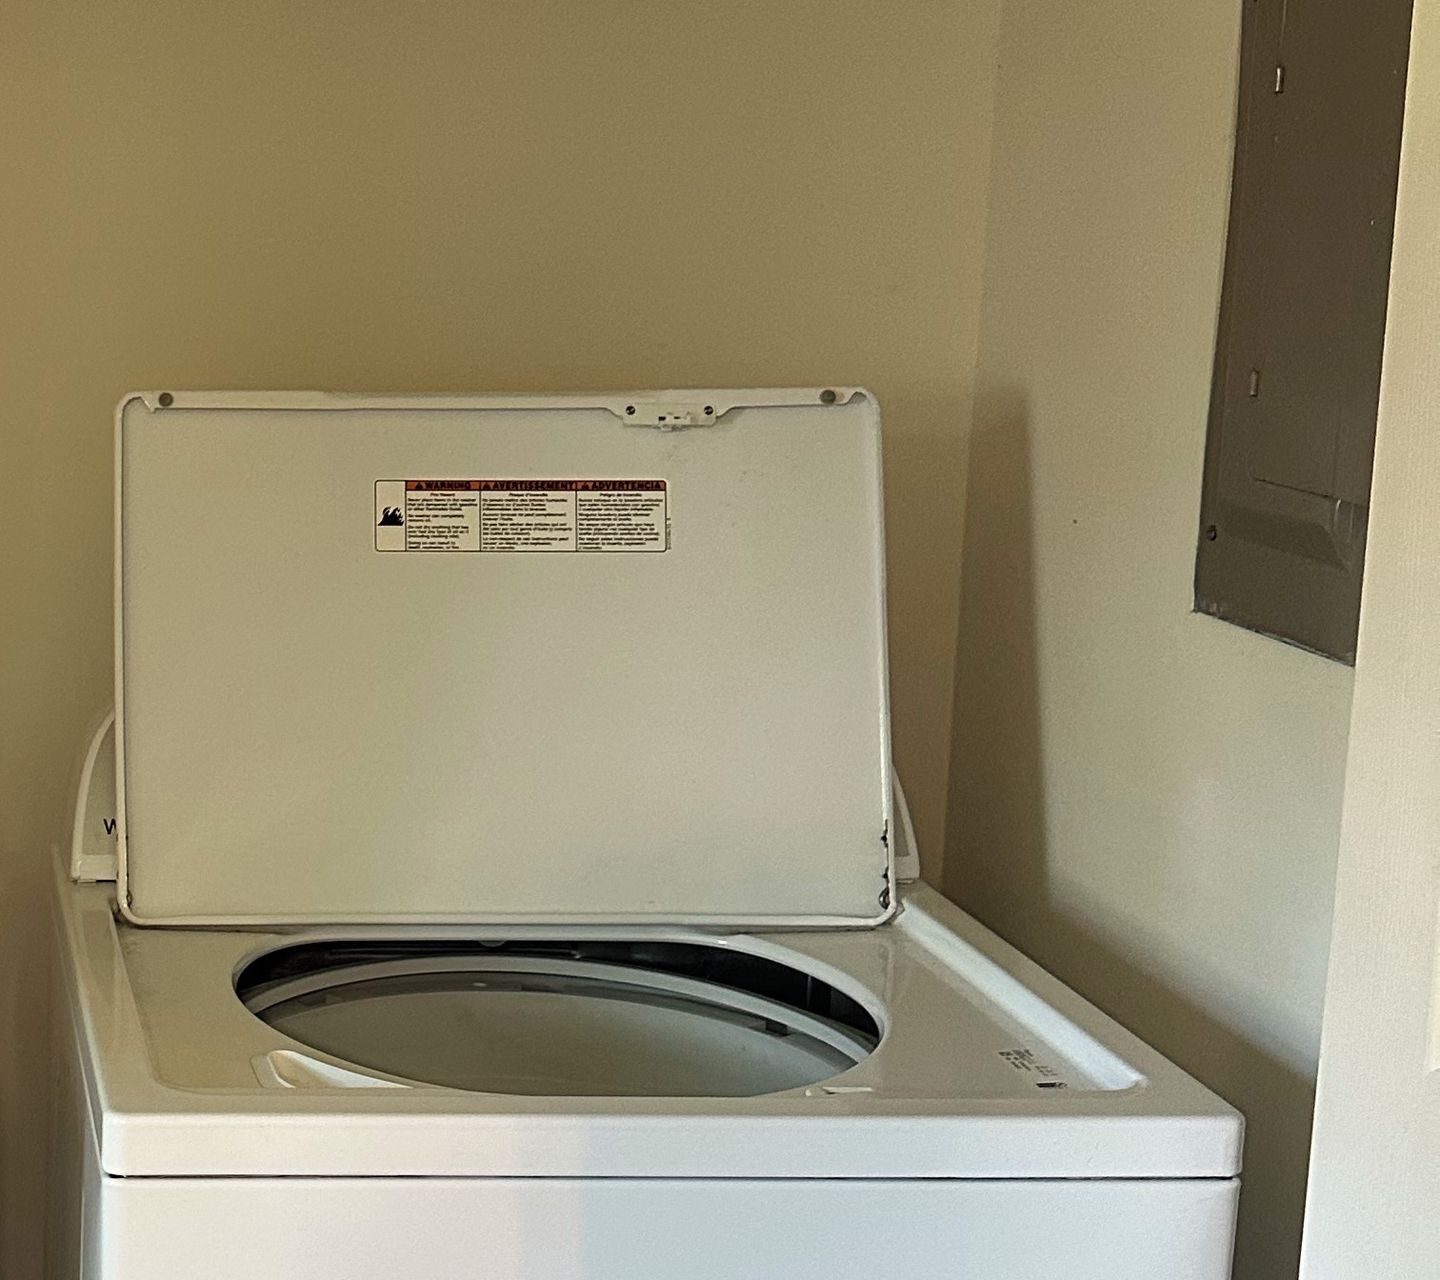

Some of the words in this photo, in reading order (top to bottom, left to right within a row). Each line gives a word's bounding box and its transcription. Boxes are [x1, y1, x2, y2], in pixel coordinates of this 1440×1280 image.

[425, 481, 471, 489] WARNING
[494, 481, 572, 489] AVERTISSEMENT
[591, 481, 662, 489] ADVERTENCIA
